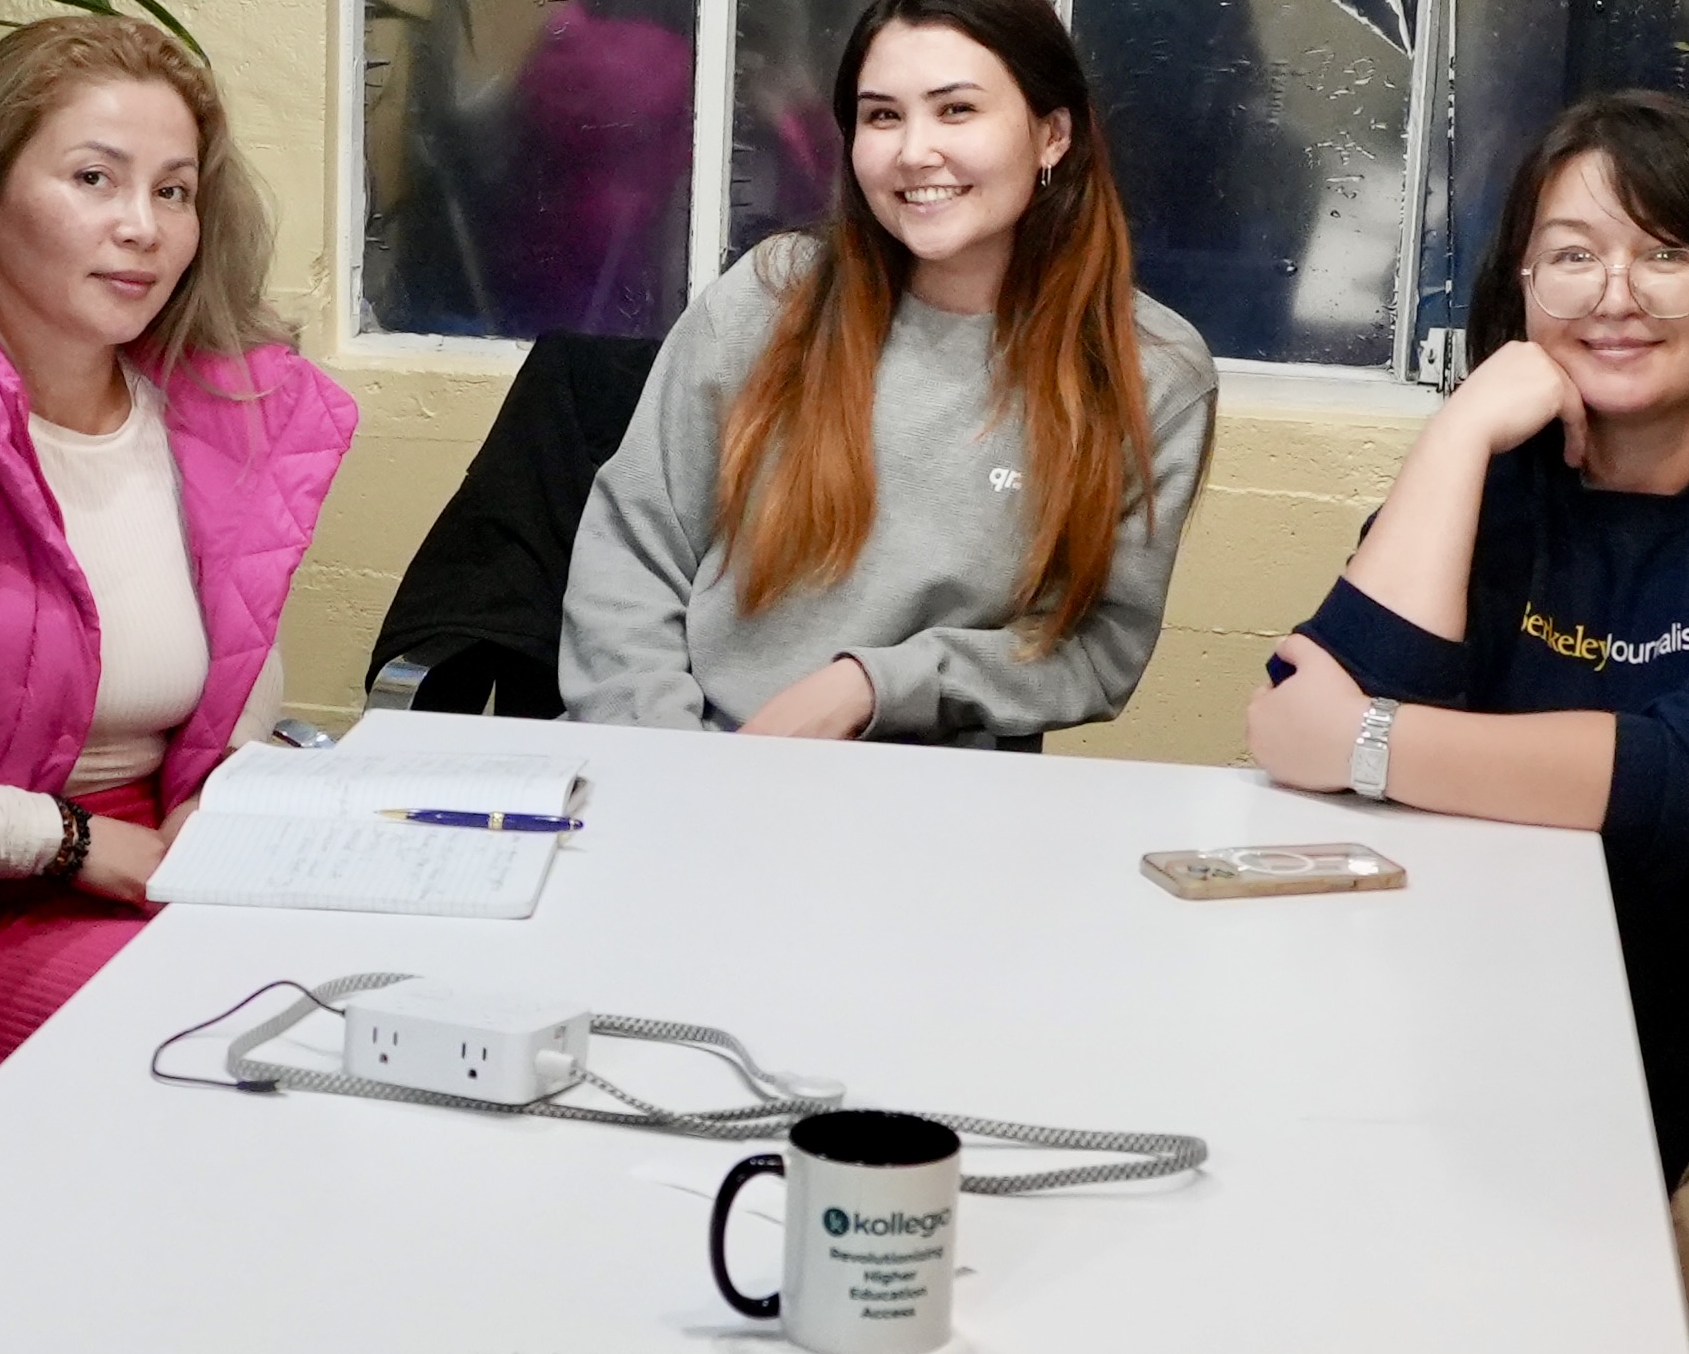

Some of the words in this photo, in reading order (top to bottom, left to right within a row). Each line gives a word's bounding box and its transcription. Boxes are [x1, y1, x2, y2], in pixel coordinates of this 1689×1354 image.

[864, 1270, 917, 1286] Higher
[849, 1286, 928, 1302] Education
[861, 1306, 916, 1319] Access
